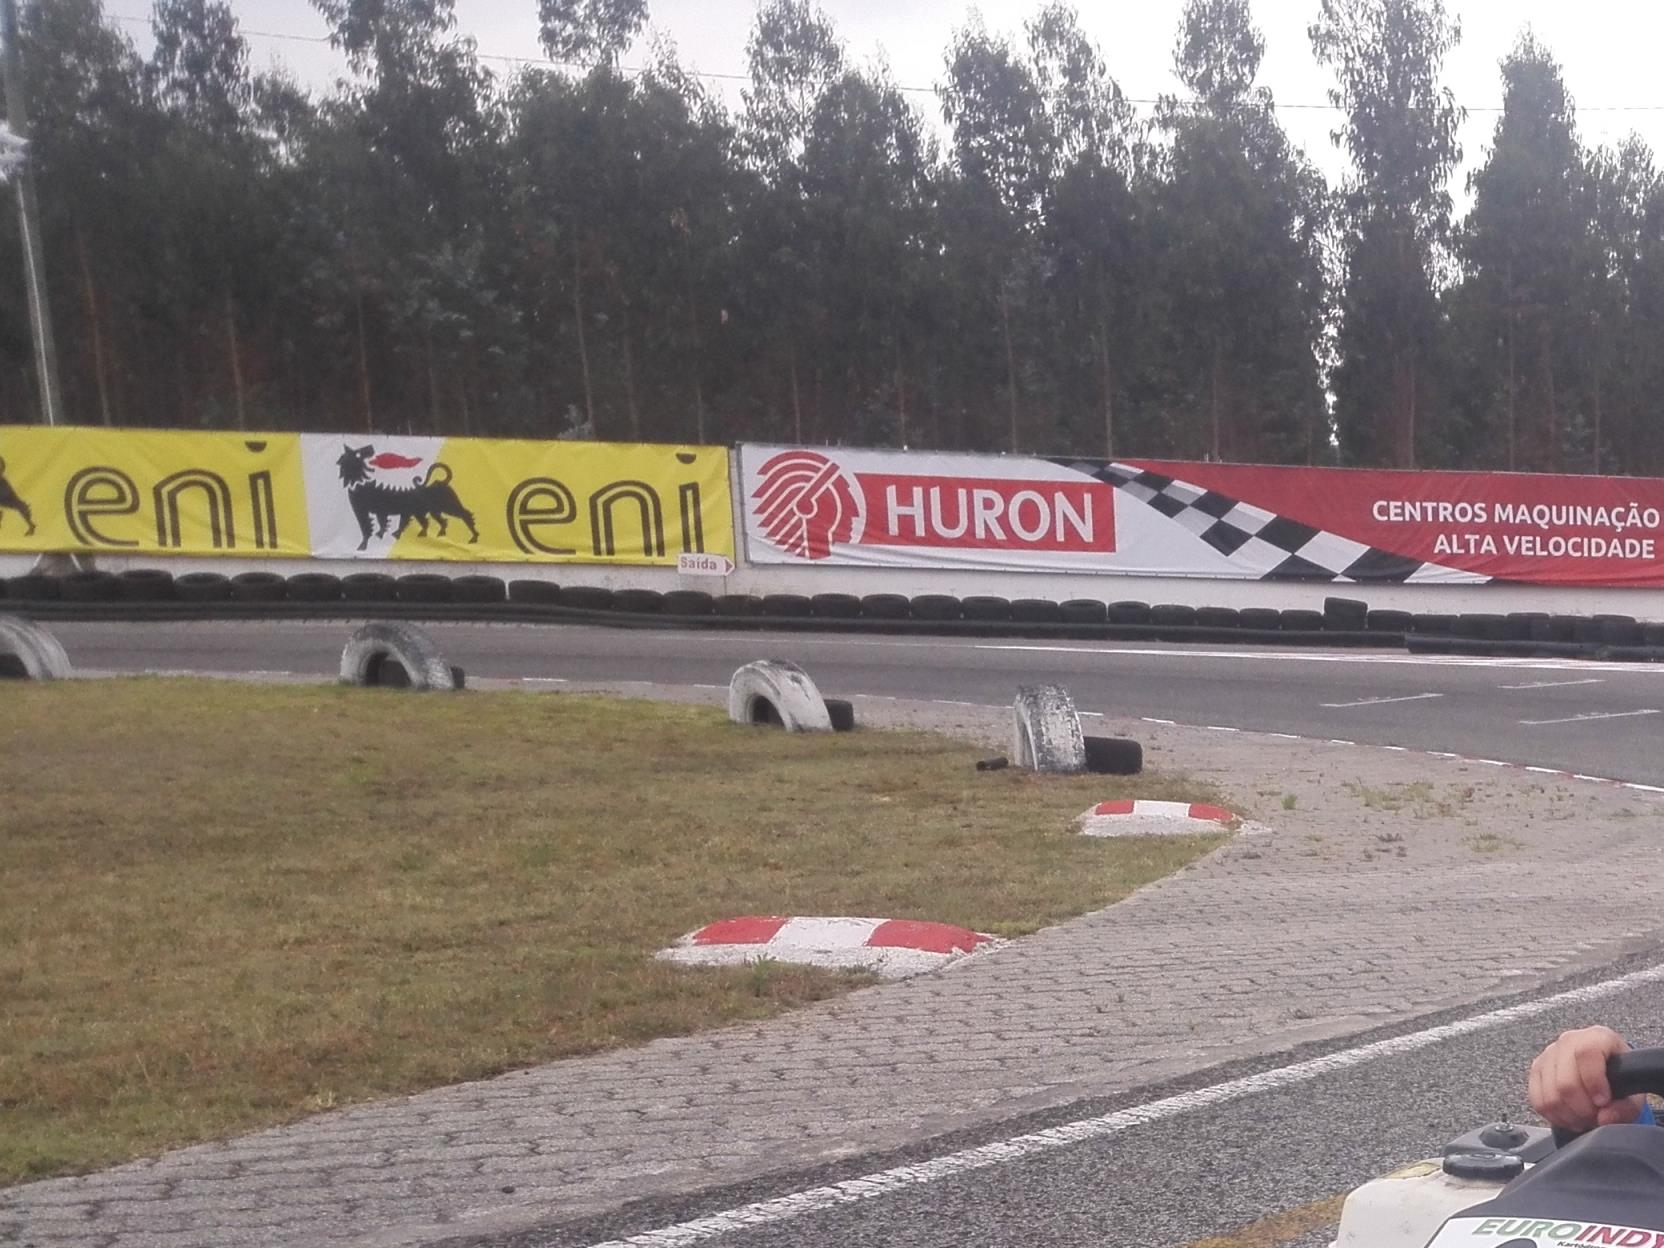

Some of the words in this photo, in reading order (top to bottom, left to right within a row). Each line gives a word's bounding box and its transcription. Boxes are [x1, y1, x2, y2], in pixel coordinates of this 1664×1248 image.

[62, 440, 279, 549] eni
[504, 452, 706, 558] eni
[885, 483, 1094, 543] HURON
[1372, 500, 1488, 524] CENTROS
[1494, 501, 1661, 533] MAQUINAÇÃO
[1433, 534, 1497, 555] ALTA
[1502, 535, 1656, 559] VELOCIDADE
